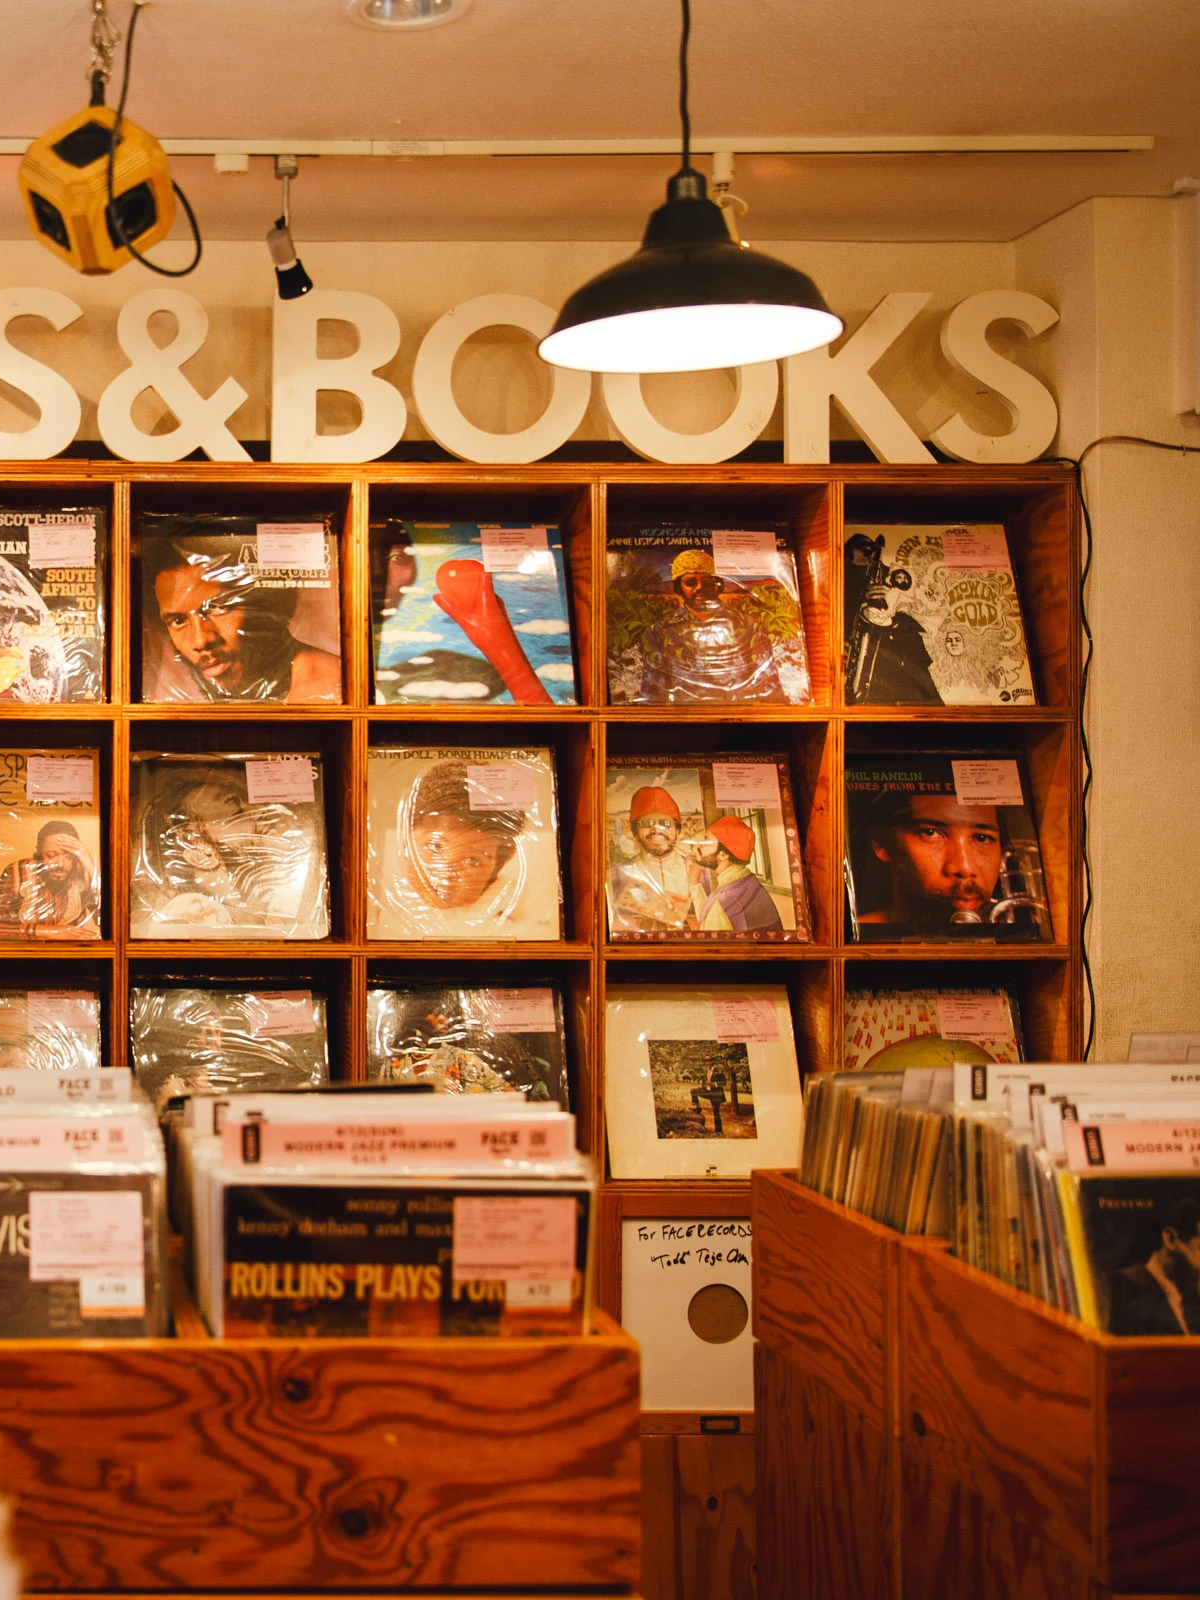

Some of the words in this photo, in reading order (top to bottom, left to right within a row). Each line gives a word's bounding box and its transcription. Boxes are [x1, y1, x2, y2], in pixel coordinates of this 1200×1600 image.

[634, 538, 665, 546] LISTON
[666, 538, 694, 546] SMITH
[895, 535, 922, 565] JOHN
[46, 569, 96, 582] SOUTH
[41, 583, 96, 597] AFRICA
[76, 597, 96, 610] TO
[953, 602, 998, 627] GOLD
[403, 751, 433, 759] DOLL
[438, 751, 471, 759] BOBBI
[845, 771, 870, 781] PHIL
[872, 771, 923, 781] RANELIN
[59, 1077, 92, 1090] FACE
[974, 1067, 984, 1098] USED
[64, 1128, 99, 1143] FACE
[482, 1130, 520, 1145] FACE
[1126, 1143, 1182, 1153] MODERN
[407, 1197, 454, 1215] rollin
[637, 1225, 656, 1242] For
[230, 1262, 345, 1300] ROLLINS
[355, 1264, 443, 1300] PLAYS
